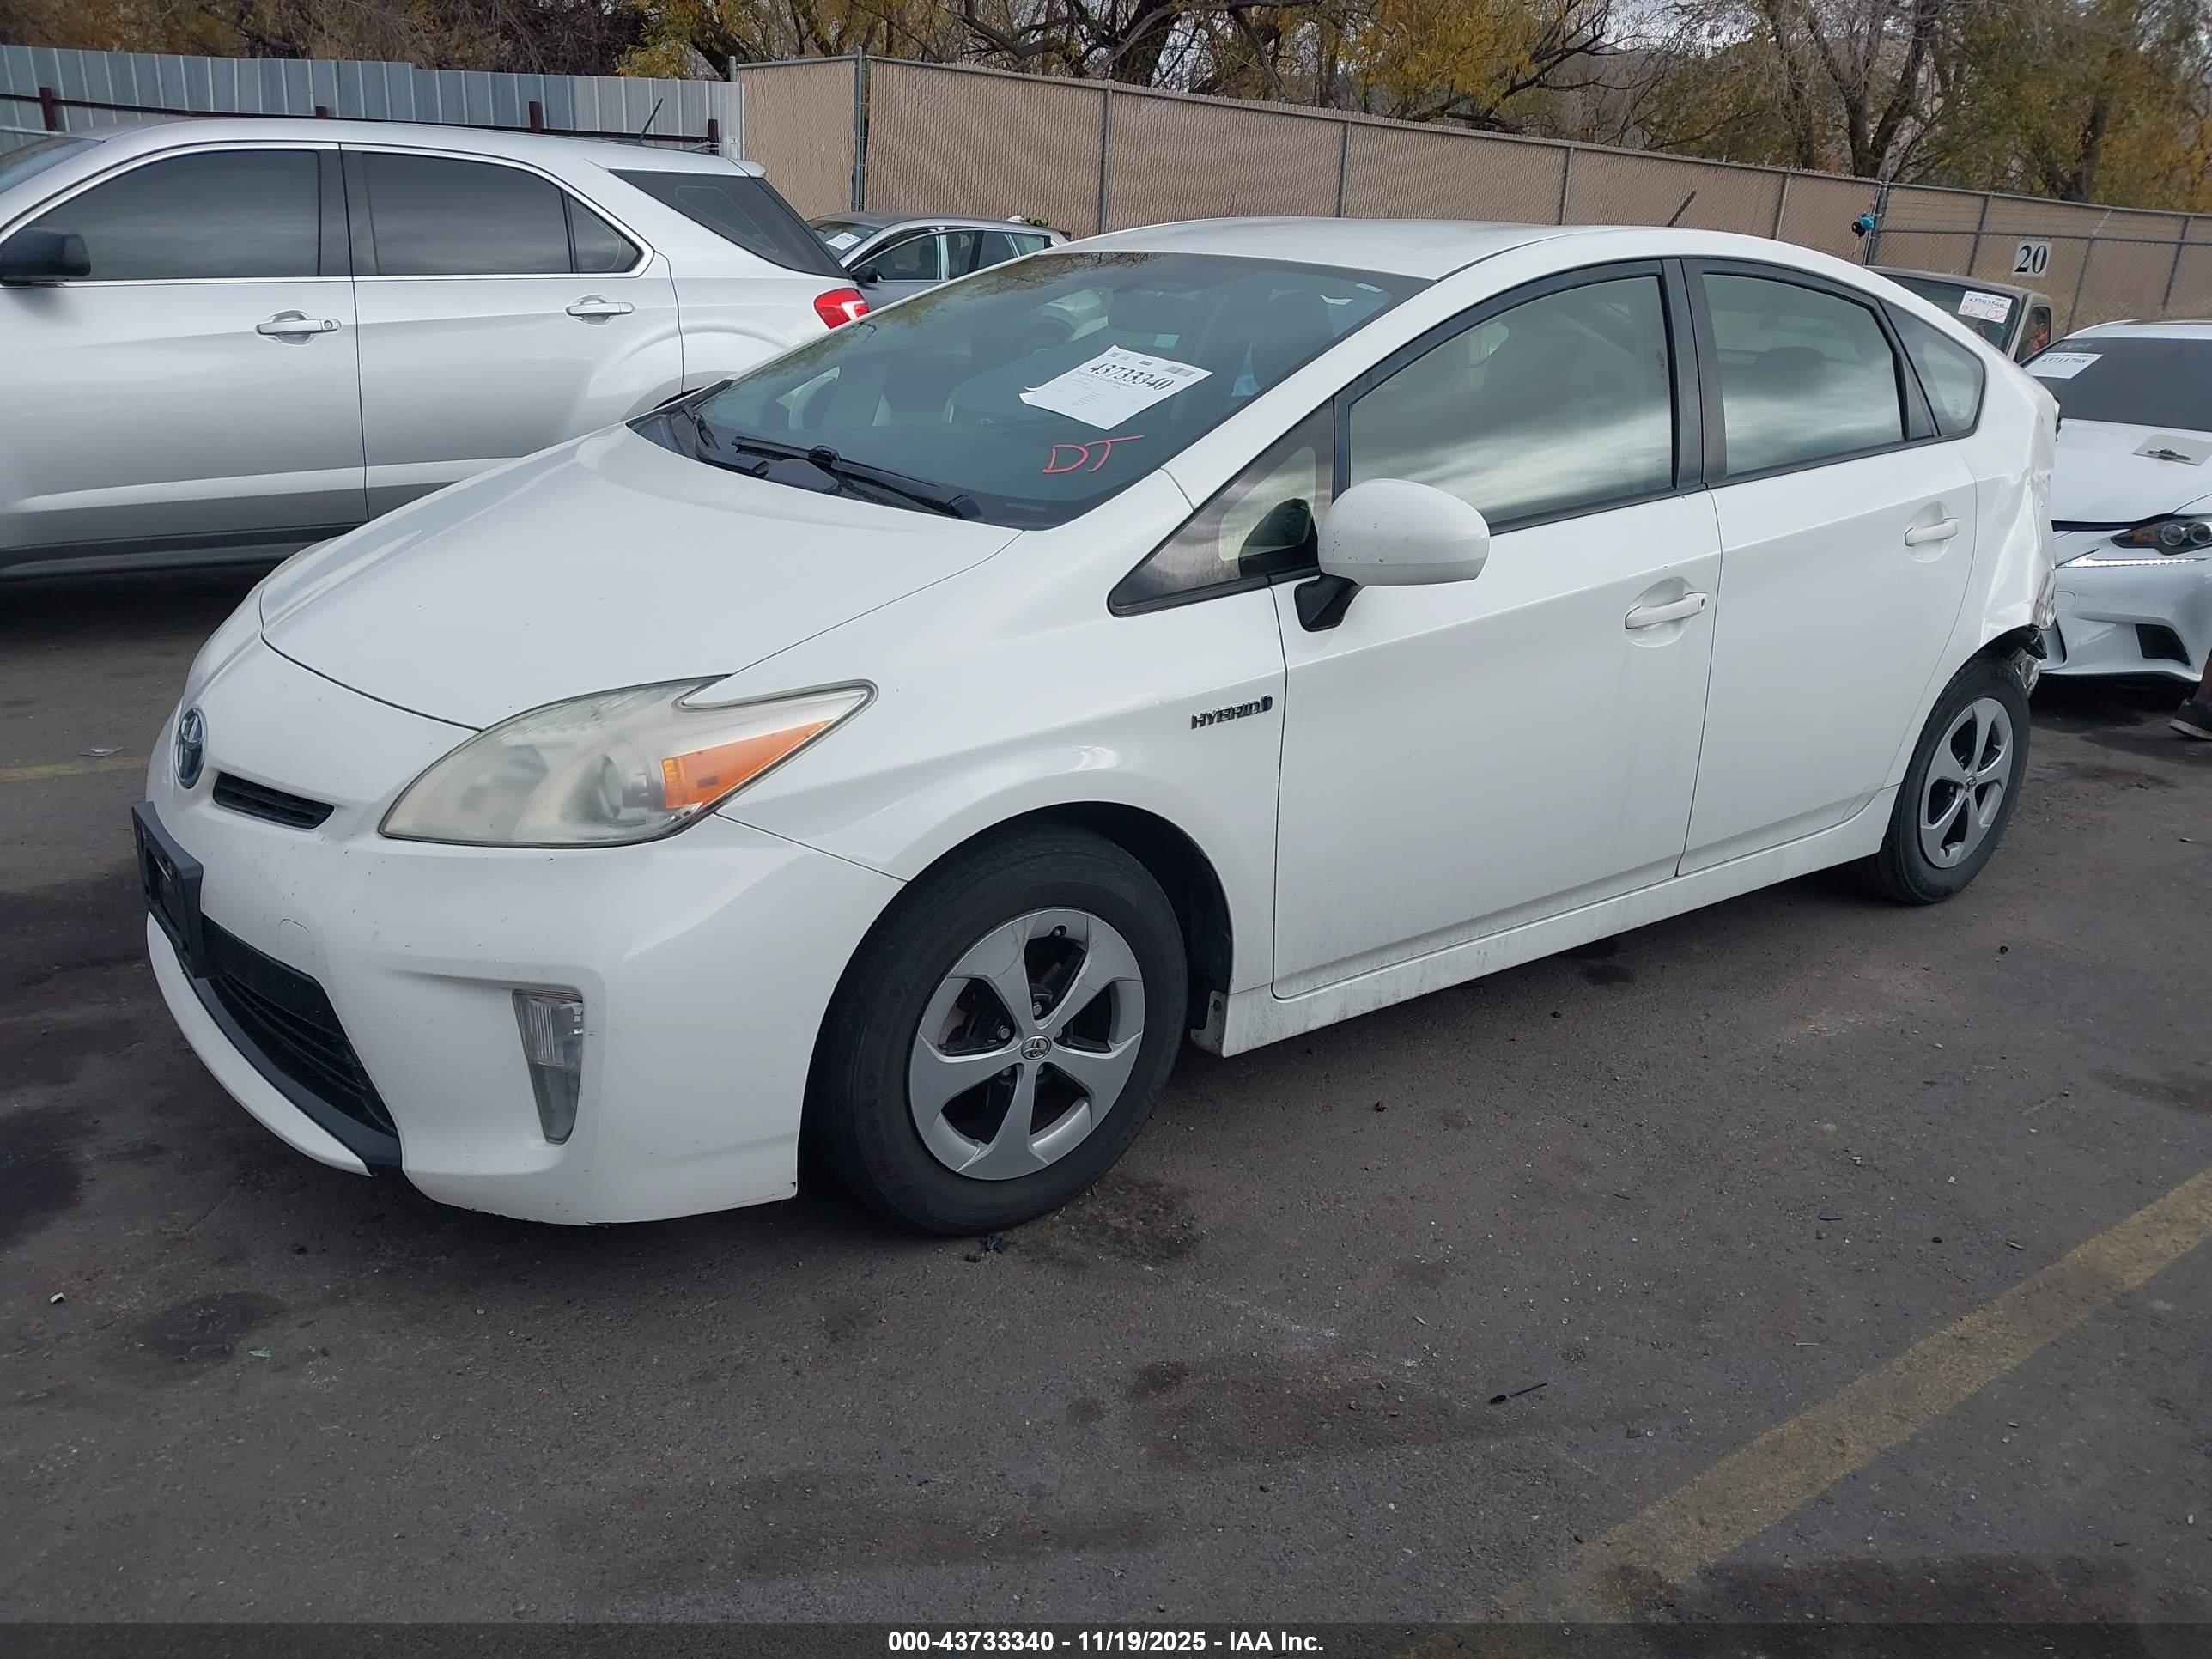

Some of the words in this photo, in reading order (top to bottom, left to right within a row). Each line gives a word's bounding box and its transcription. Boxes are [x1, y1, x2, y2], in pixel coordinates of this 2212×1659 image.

[2014, 245, 2048, 274] 20
[1089, 362, 1175, 391] 43733340
[1042, 434, 1145, 474] DT
[1191, 700, 1261, 729] HYBRID
